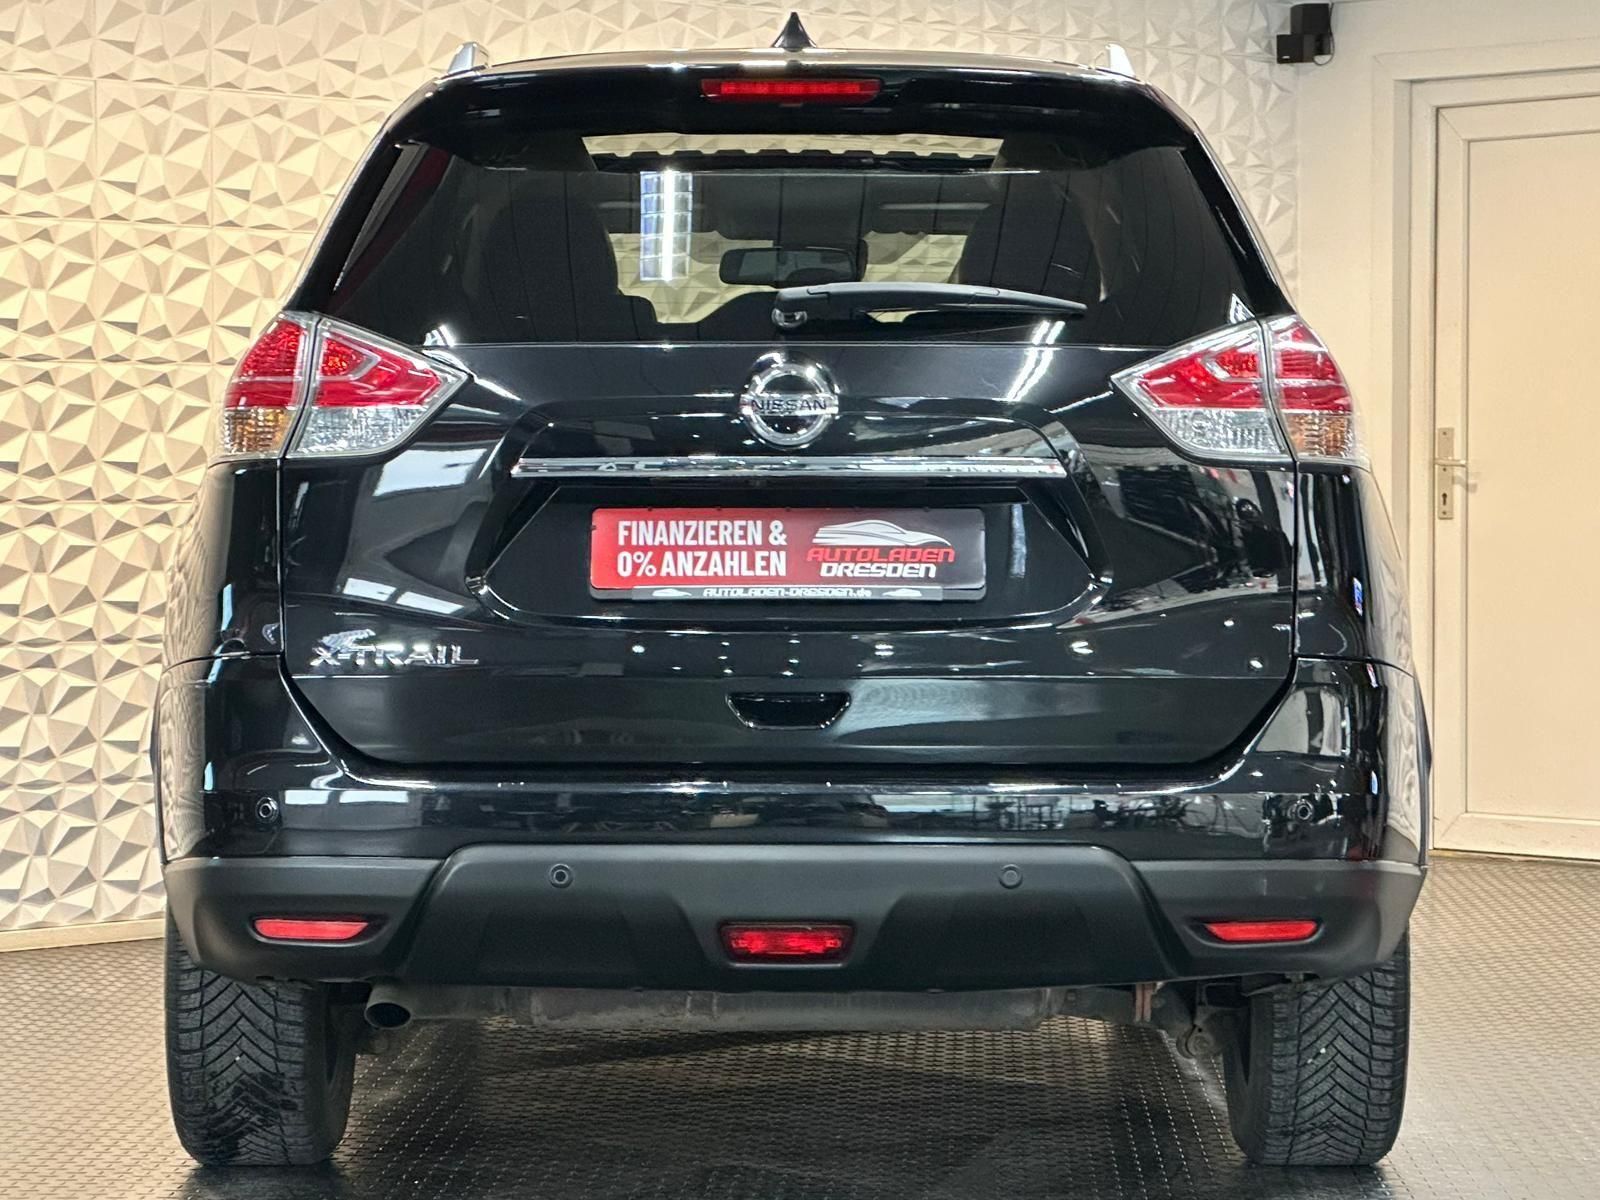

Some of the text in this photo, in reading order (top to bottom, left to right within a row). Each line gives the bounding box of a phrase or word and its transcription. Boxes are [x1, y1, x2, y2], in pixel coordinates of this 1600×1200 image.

[751, 399, 827, 411] NISSAN
[617, 520, 788, 546] FINANZIEREN &
[807, 547, 955, 562] AUTOLADEN
[617, 551, 787, 578] 0% ANZAHLEN
[820, 563, 936, 578] DRESDEN
[310, 644, 480, 667] X-TRAIL
